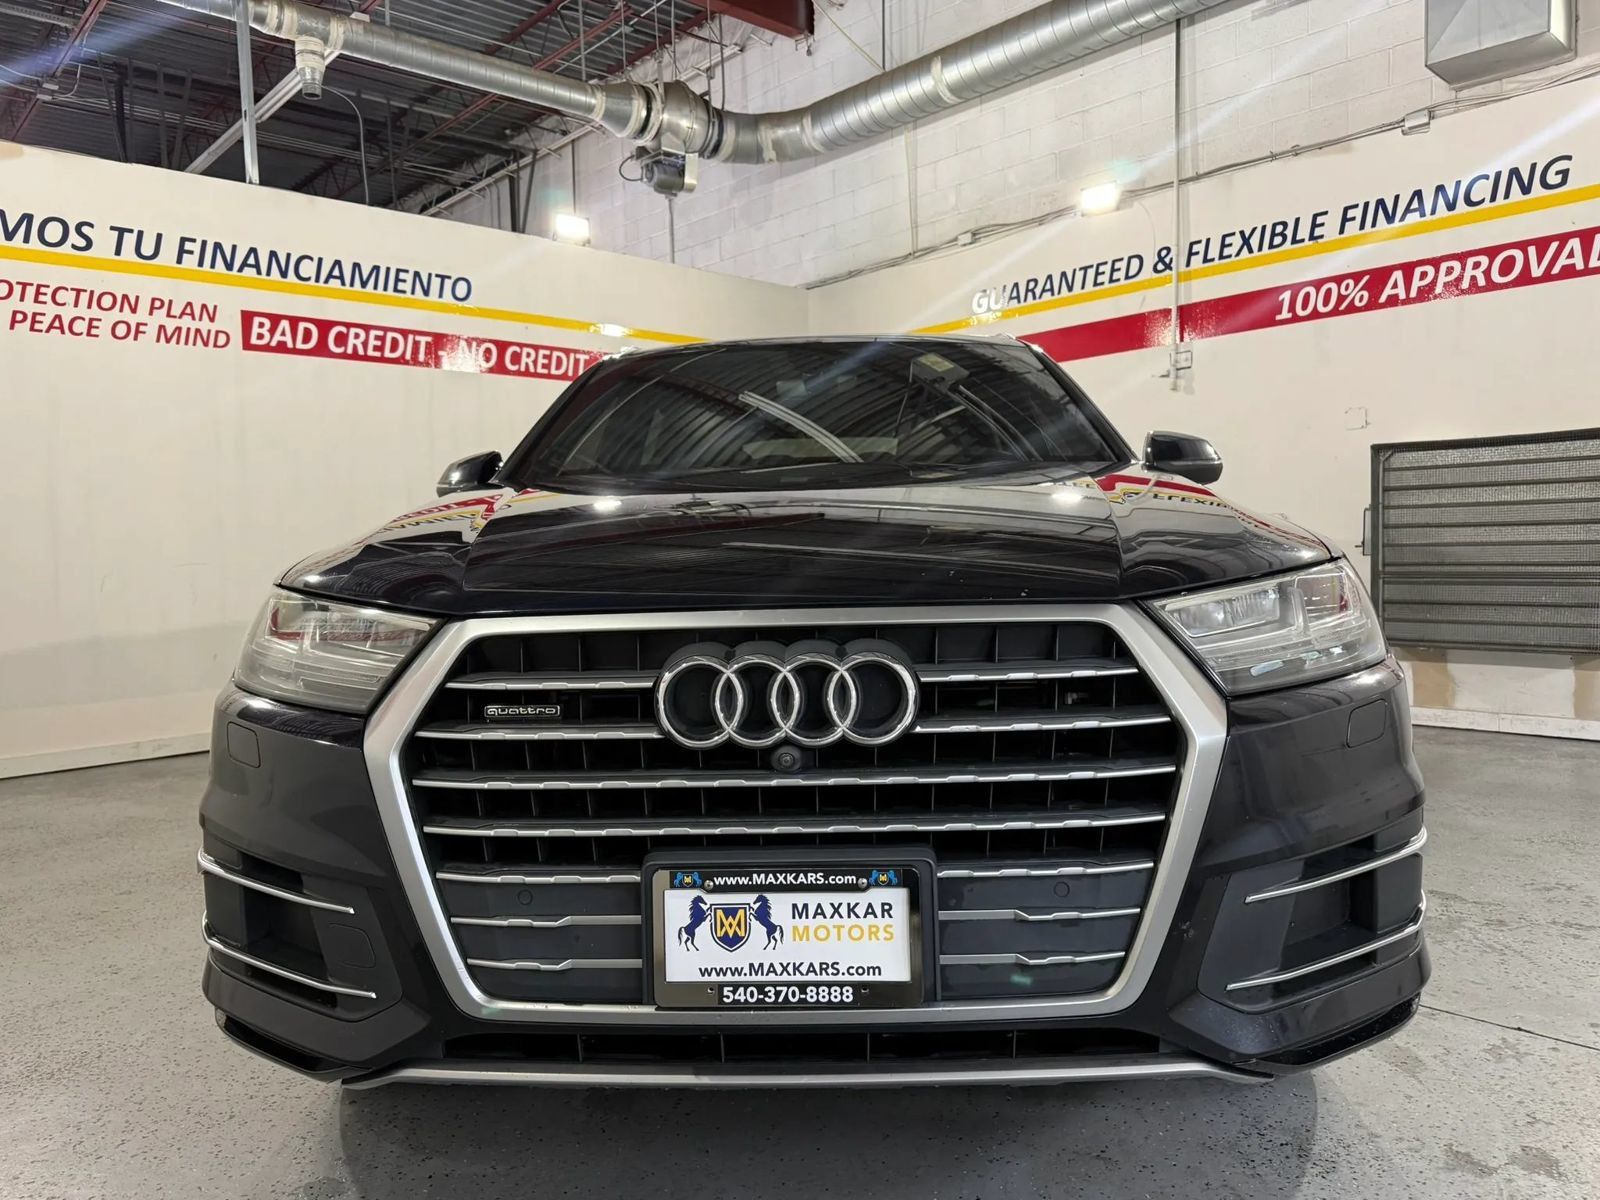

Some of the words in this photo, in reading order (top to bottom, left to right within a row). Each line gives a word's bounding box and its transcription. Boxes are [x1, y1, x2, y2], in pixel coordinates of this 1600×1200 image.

[972, 254, 1145, 314] GUARANTEED
[1152, 246, 1174, 274] &
[1185, 210, 1329, 268] FLEXIBLE
[1338, 154, 1573, 236] FINANCING
[0, 208, 95, 252] MOS
[109, 225, 163, 261] TU
[176, 236, 473, 303] FINANCIAMIENTO
[0, 279, 140, 315] OTECTION
[148, 297, 218, 324] PLAN
[1275, 274, 1370, 321] 100%
[9, 309, 102, 338] PEACE
[110, 320, 148, 342] OF
[155, 324, 231, 349] MIND
[250, 316, 319, 350] BAD
[327, 325, 433, 363] CREDIT
[504, 345, 590, 377] CREDIT
[487, 707, 556, 716] quattro
[713, 872, 857, 886] www.MAXKARS.com
[791, 902, 894, 920] MAXKAR
[791, 924, 895, 943] MOTORS
[698, 961, 882, 979] www.MAXKARS.com
[722, 985, 854, 1004] 540-370-8888
